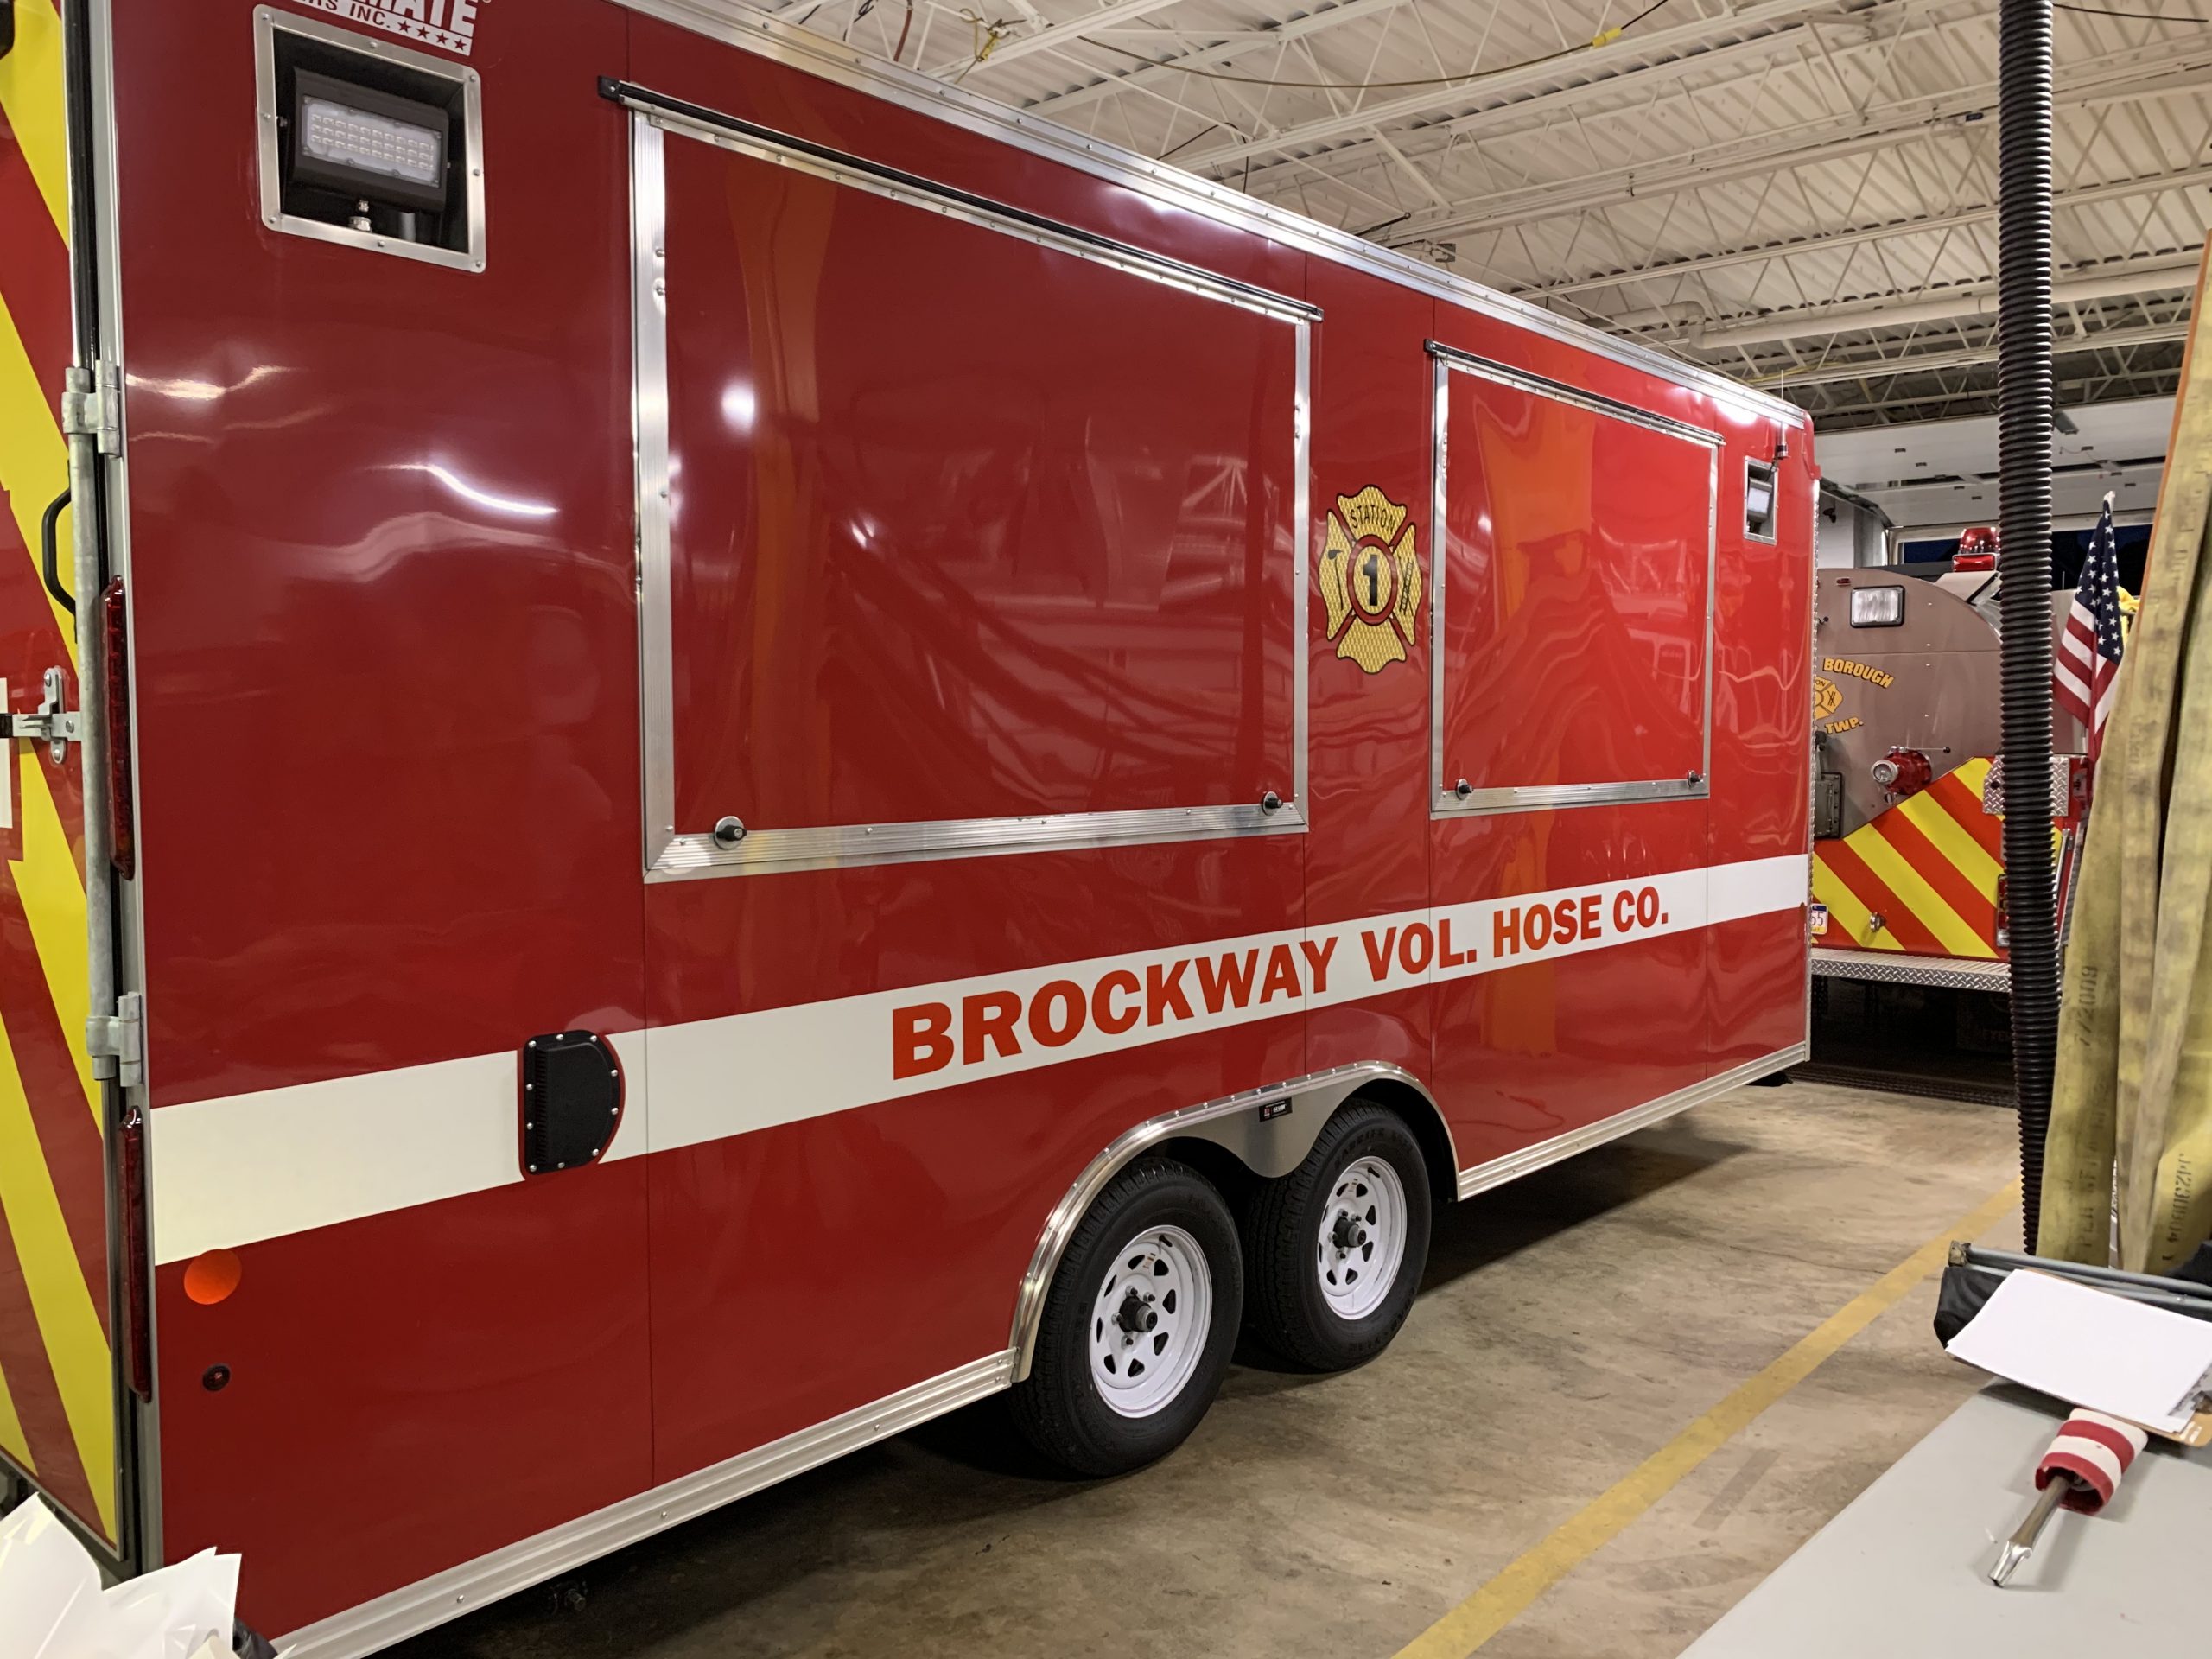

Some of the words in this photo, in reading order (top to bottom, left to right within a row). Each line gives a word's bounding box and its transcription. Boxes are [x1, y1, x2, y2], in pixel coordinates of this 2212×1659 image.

[349, 3, 390, 28] INC.
[1351, 504, 1396, 534] STATION
[1363, 554, 1378, 607] 1
[1822, 658, 1895, 689] BOROUGH
[1825, 716, 1864, 734] TWP.
[893, 936, 1339, 1081] BROCKWAY
[1361, 918, 1477, 982] VOL.
[1493, 894, 1602, 958] HOSE
[1613, 886, 1669, 932] CO.
